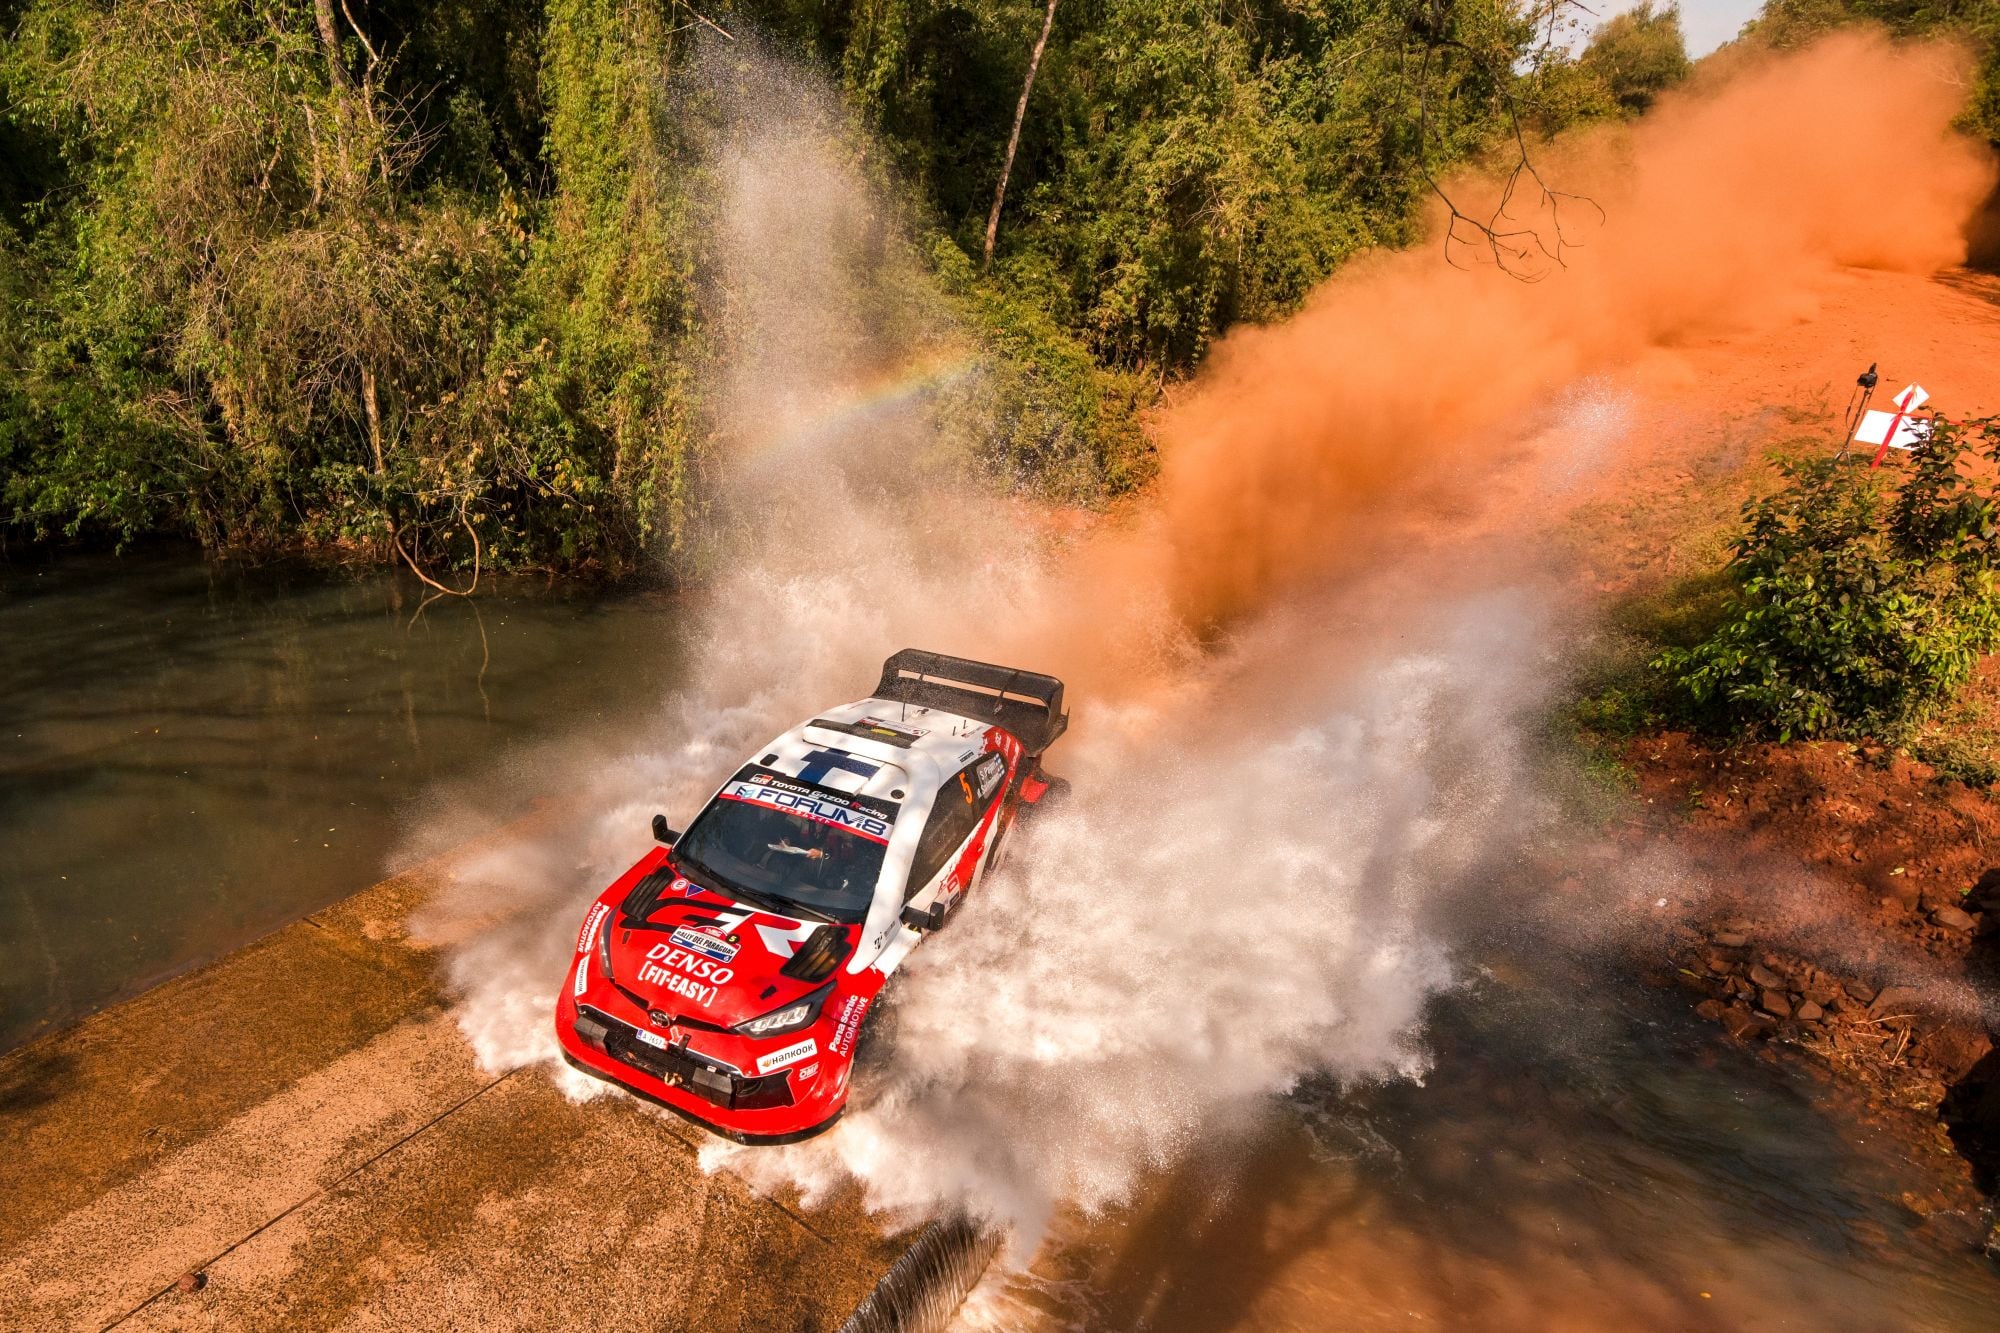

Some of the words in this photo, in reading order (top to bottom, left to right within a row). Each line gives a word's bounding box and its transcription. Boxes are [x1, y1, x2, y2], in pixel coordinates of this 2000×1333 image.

[771, 780, 810, 794] TOYOTA
[850, 801, 888, 820] Racing
[959, 772, 973, 804] 5
[757, 788, 887, 836] FORUM8
[677, 930, 692, 940] RALLY
[692, 935, 704, 945] DEL
[703, 939, 735, 955] PARAGUAY
[646, 943, 734, 985] DENSO
[828, 995, 858, 1053] Panasonic
[840, 997, 868, 1058] AUTOMOTIVE
